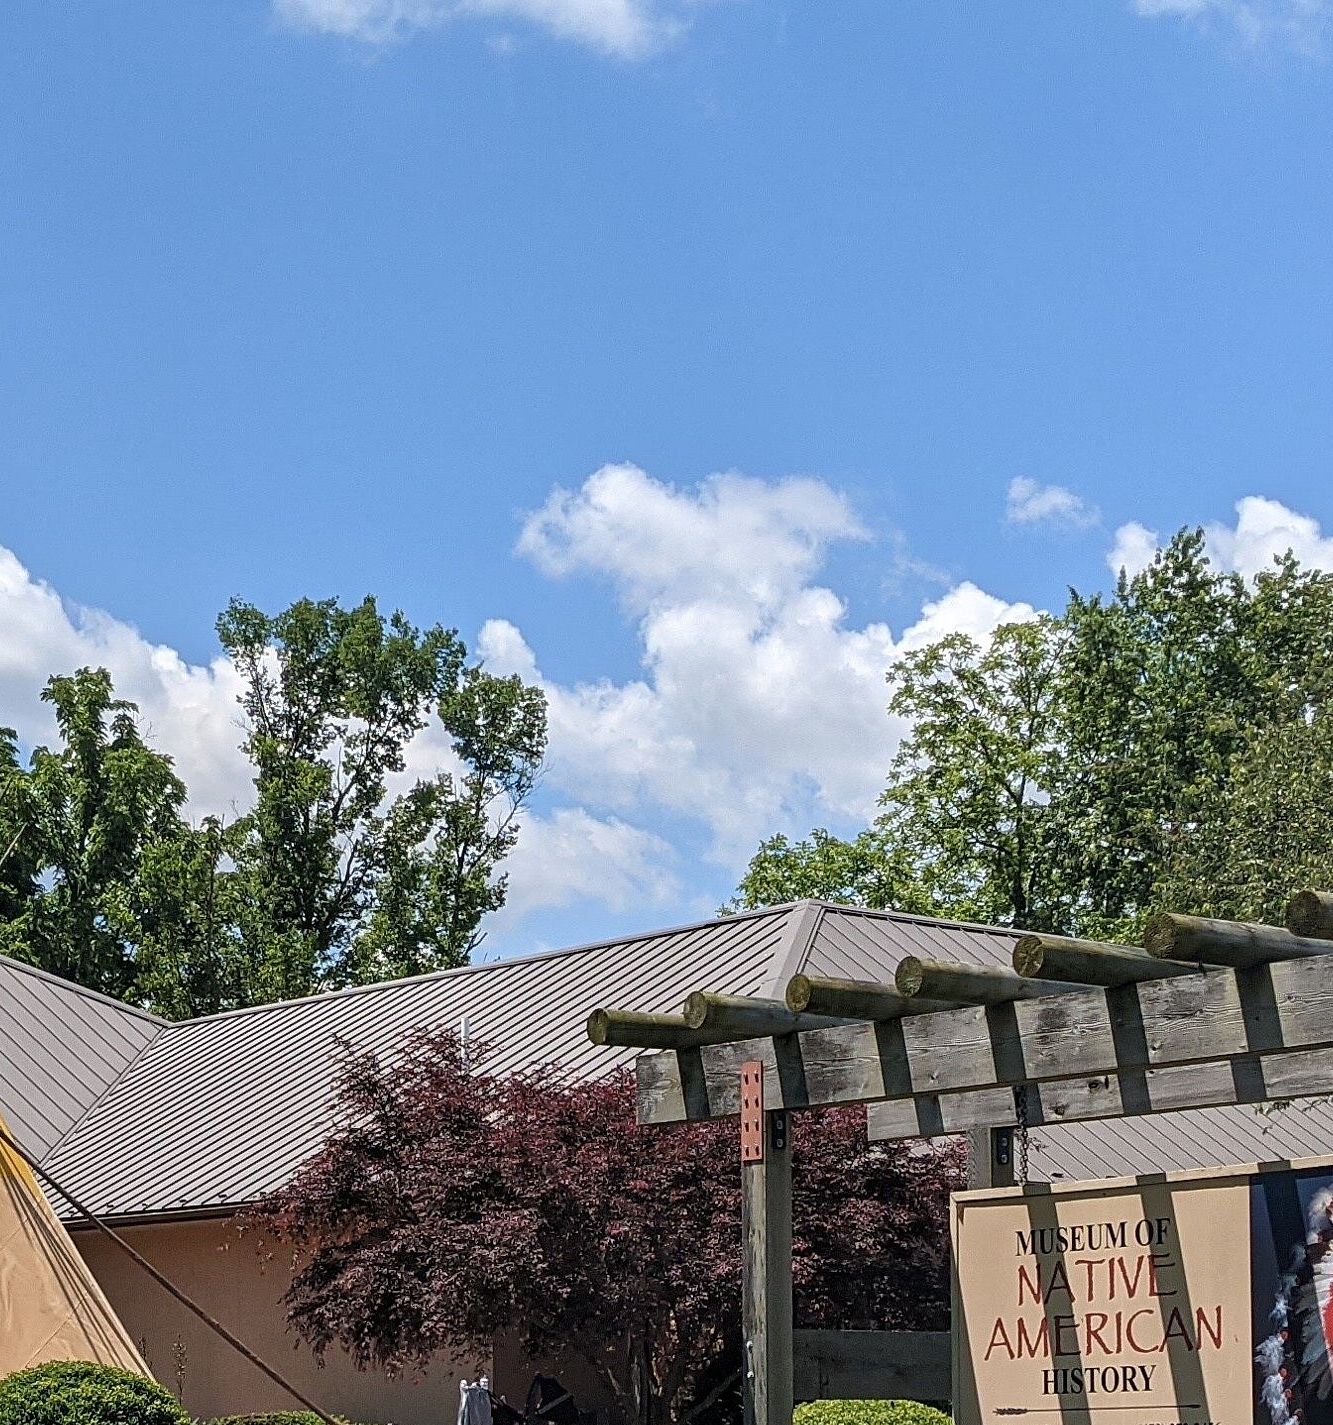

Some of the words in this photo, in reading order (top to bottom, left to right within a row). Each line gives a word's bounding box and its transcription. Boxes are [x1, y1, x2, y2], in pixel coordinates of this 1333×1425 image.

[1015, 1221, 1127, 1256] MUSEUM
[1135, 1218, 1170, 1246] OF
[1018, 1254, 1178, 1306] NATIVE
[984, 1305, 1222, 1361] AMERICAN
[1041, 1365, 1157, 1395] HISTORY
